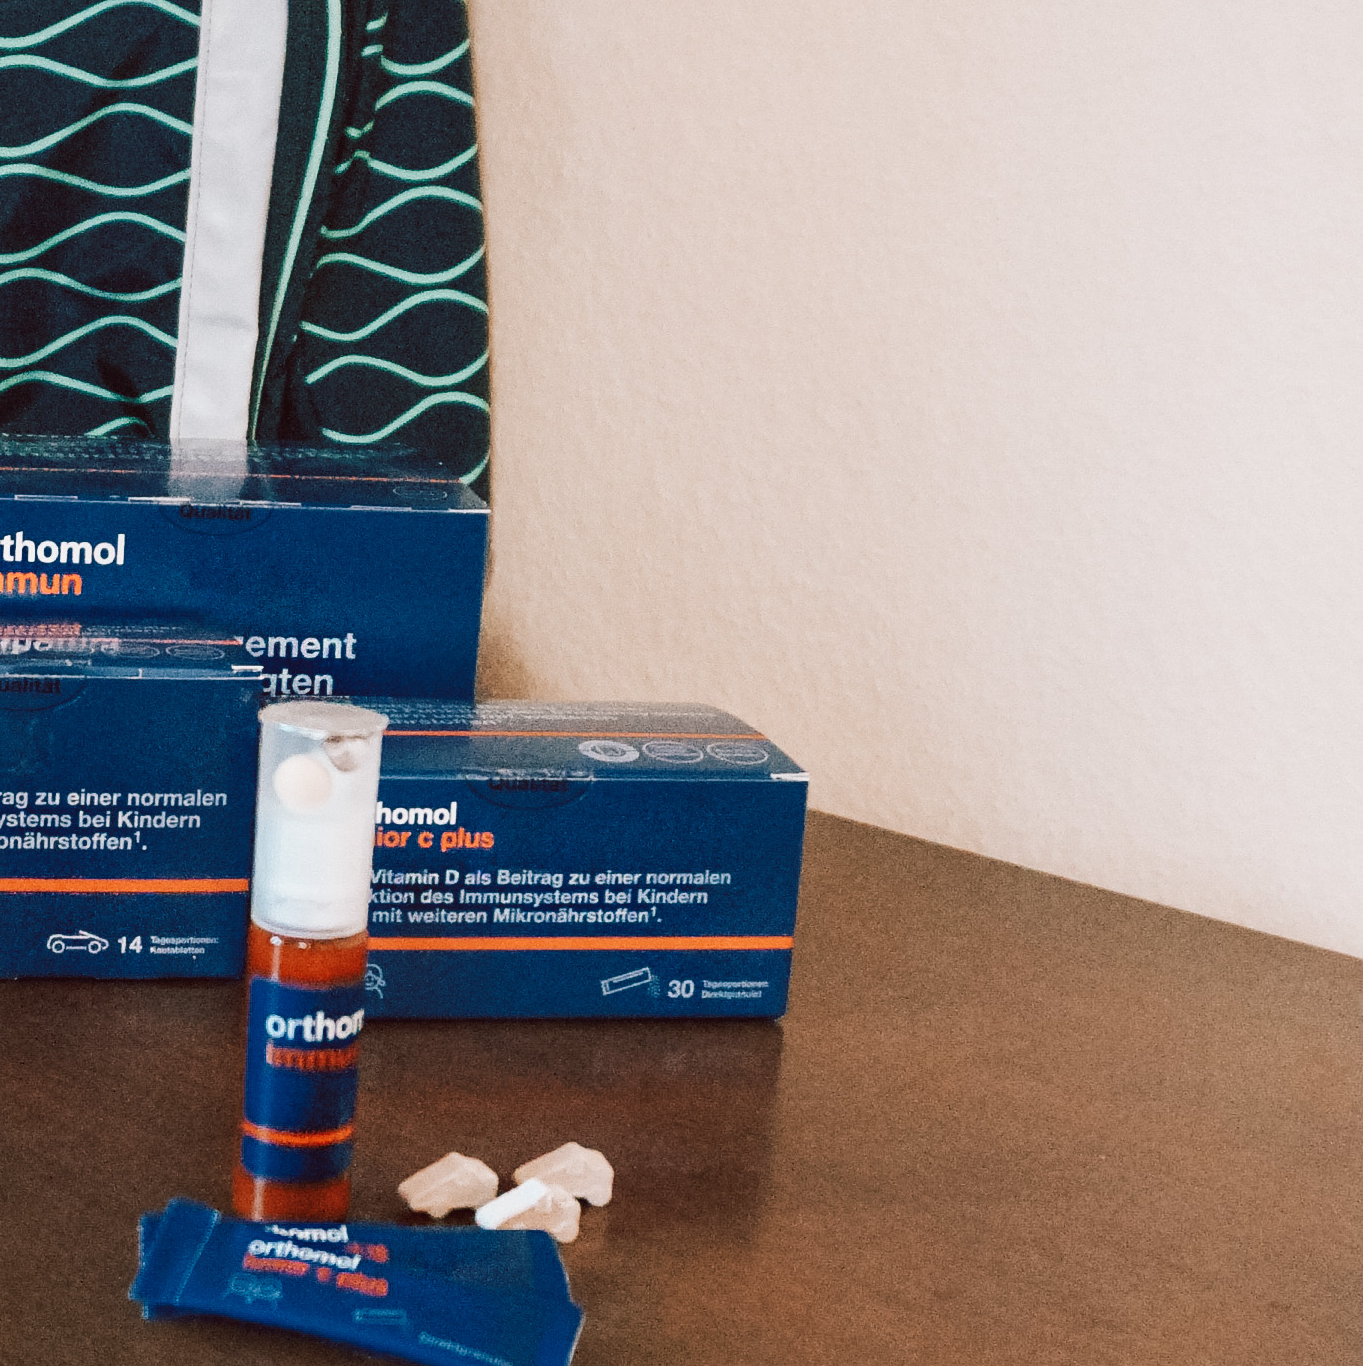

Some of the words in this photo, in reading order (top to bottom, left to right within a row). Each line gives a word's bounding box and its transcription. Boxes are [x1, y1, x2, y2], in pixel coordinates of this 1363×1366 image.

[239, 633, 356, 659] ement
[35, 792, 60, 805] zu
[67, 789, 121, 805] einer
[128, 789, 226, 806] normalen
[79, 811, 110, 827] bei
[118, 811, 200, 828] Kindern
[375, 801, 457, 825] homol
[374, 826, 411, 847] ior
[418, 831, 434, 848] c
[441, 827, 494, 852] plus
[372, 869, 439, 885] Vitamin
[445, 870, 459, 884] D
[465, 871, 491, 885] als
[497, 870, 563, 888] Beitrag
[569, 874, 590, 884] zu
[595, 870, 641, 884] einer
[646, 870, 731, 884] normalen
[421, 889, 453, 904] des
[460, 890, 598, 907] Immunsystems
[605, 890, 631, 904] bei
[638, 889, 708, 903] Kindern
[373, 908, 402, 922] mit
[408, 909, 487, 923] weiteren
[118, 936, 142, 953] 14
[668, 980, 694, 998] 30
